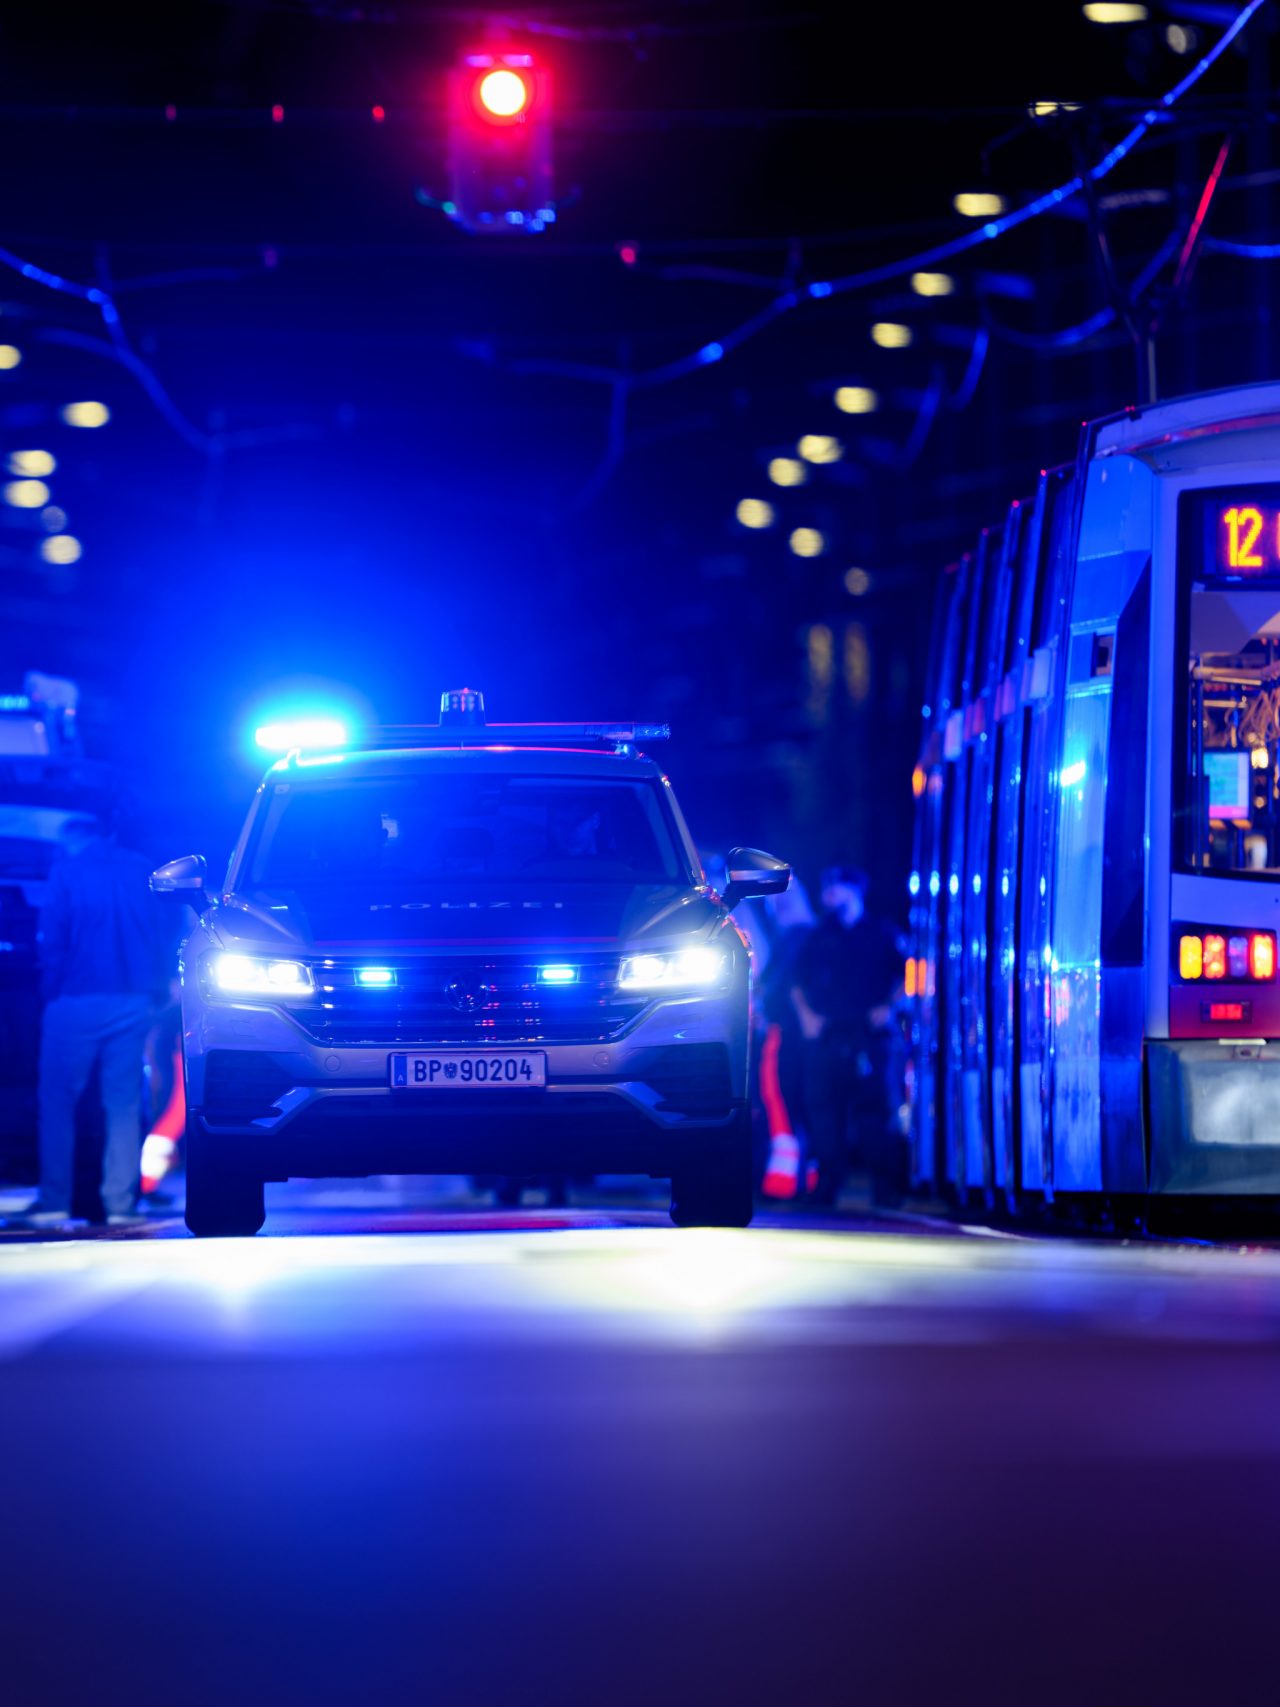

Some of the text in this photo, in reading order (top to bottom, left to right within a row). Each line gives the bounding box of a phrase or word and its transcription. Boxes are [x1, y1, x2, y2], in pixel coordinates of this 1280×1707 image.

[1224, 507, 1263, 567] 12
[369, 902, 563, 911] POLIZEI
[414, 1059, 441, 1082] BP
[460, 1058, 532, 1082] 90204
